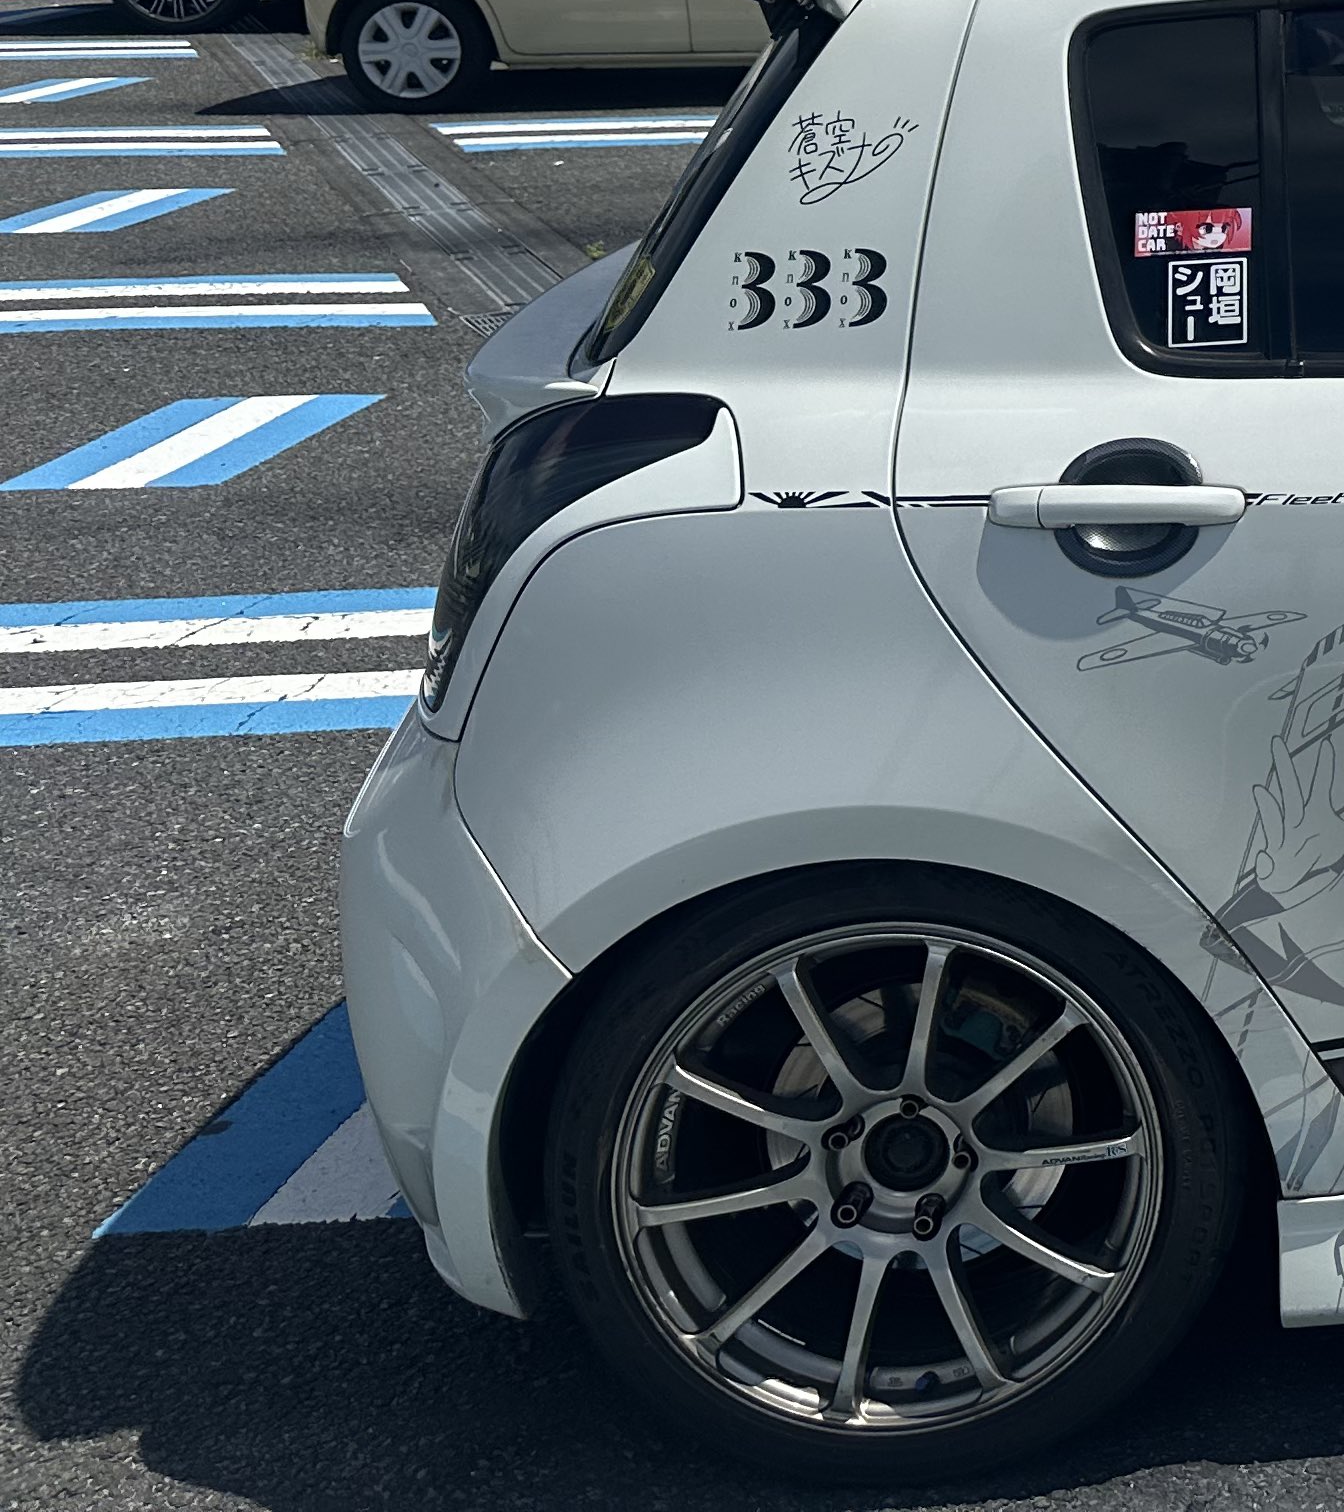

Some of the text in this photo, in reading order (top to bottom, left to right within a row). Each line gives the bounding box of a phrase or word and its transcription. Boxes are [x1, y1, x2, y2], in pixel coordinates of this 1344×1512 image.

[1136, 212, 1167, 225] NOT
[1138, 225, 1175, 238] DATE
[1137, 239, 1166, 251] CAR
[1174, 266, 1204, 341] シュー
[1208, 263, 1241, 325] 岡垣
[716, 984, 766, 1025] Racing
